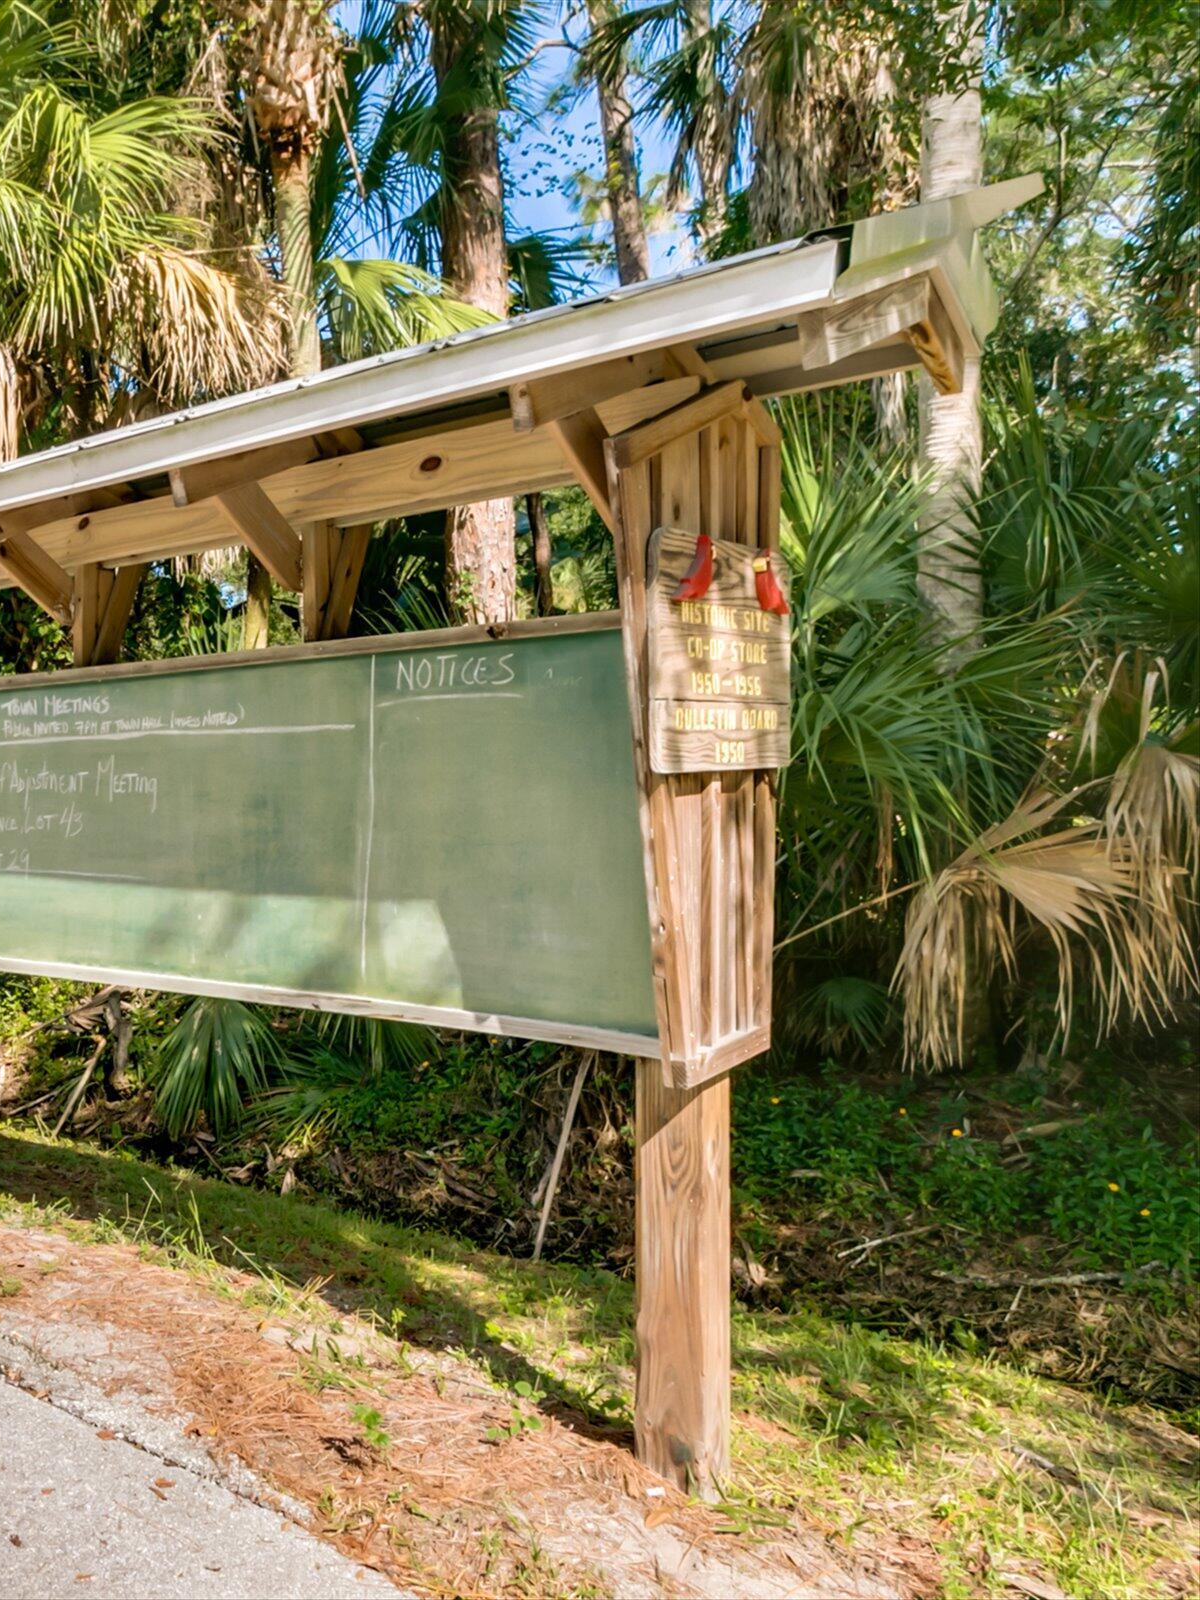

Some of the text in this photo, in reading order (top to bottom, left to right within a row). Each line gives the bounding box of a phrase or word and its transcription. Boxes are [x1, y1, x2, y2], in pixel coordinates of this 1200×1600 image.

[681, 601, 770, 633] HISTORIC SITE
[687, 635, 768, 664] CO-OP STORE
[396, 653, 515, 690] NOTICES
[1, 694, 110, 717] TOWN MEETINGS
[675, 708, 778, 730] BULLETIN BOARD
[714, 741, 745, 764] 1950
